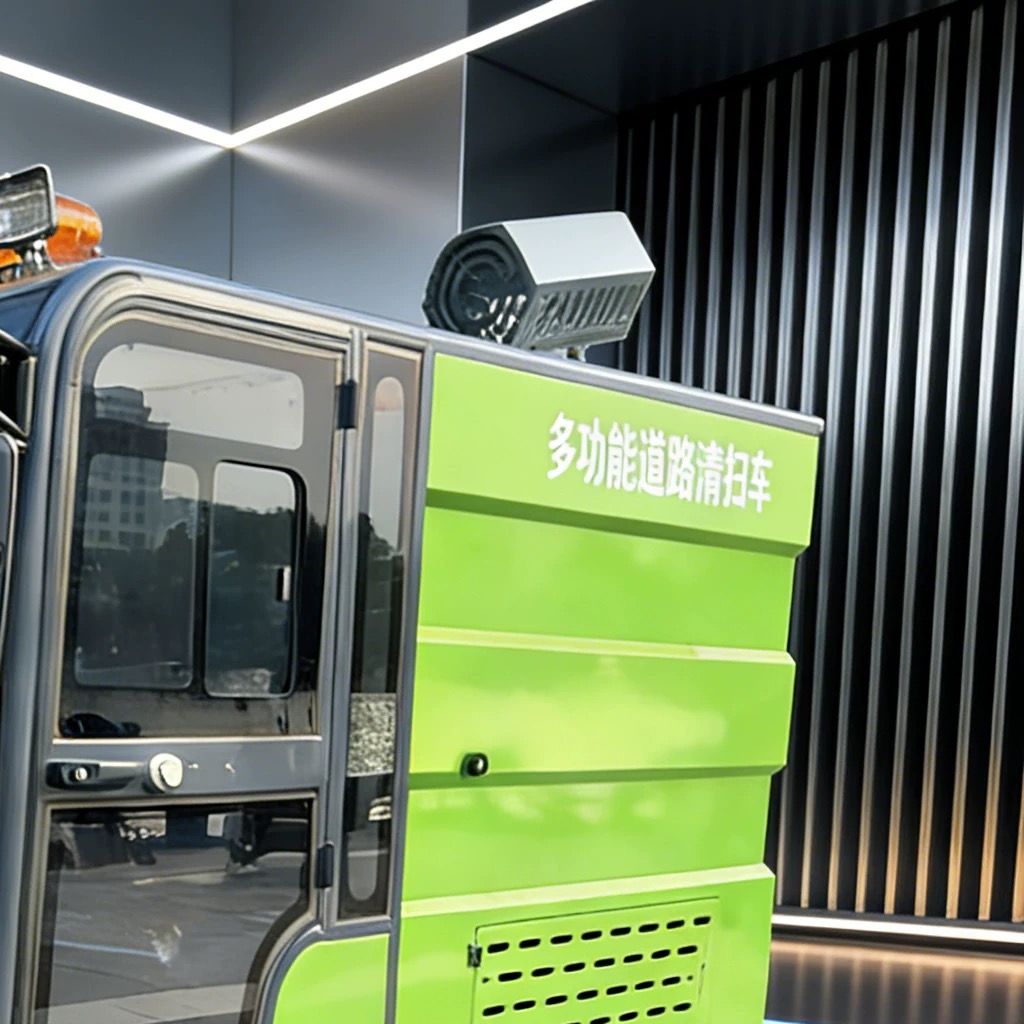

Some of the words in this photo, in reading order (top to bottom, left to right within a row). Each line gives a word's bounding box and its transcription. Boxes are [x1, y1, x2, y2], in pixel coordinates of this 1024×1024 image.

[547, 411, 773, 513] 多功能道路清扫车
